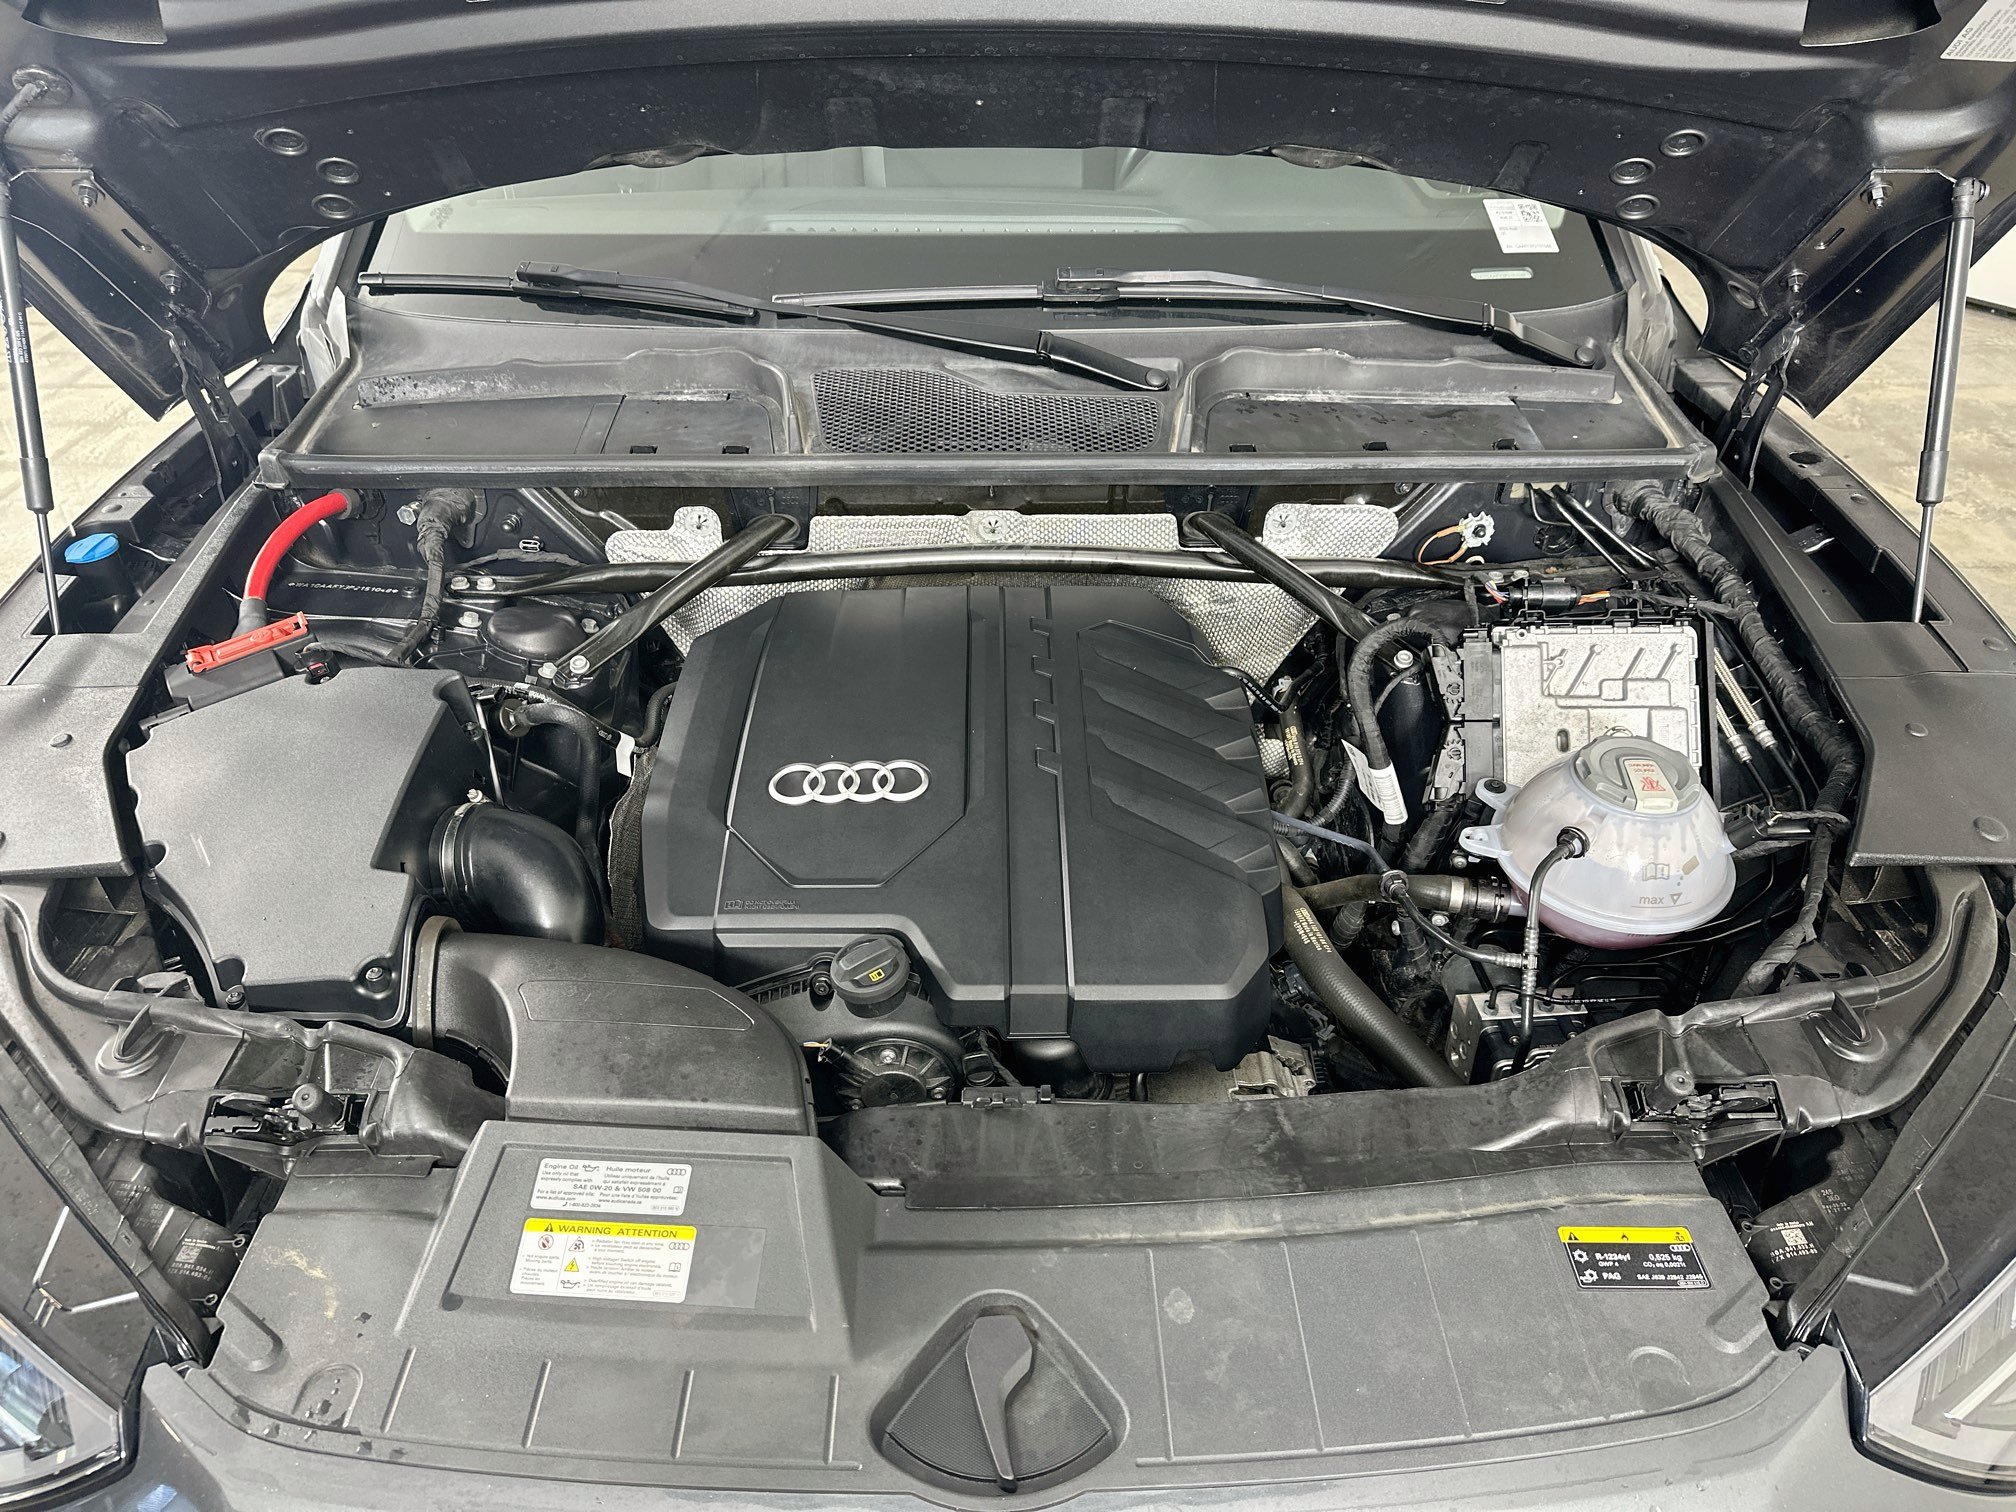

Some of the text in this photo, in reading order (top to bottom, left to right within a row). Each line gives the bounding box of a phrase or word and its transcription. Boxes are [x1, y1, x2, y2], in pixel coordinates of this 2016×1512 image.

[1947, 40, 1962, 56] AUDI
[1639, 896, 1664, 904] max
[558, 1225, 677, 1238] WARNING ATTENTION
[1595, 1253, 1683, 1262] R-1234yf 0,525 kg
[1602, 1272, 1621, 1280] PAG
